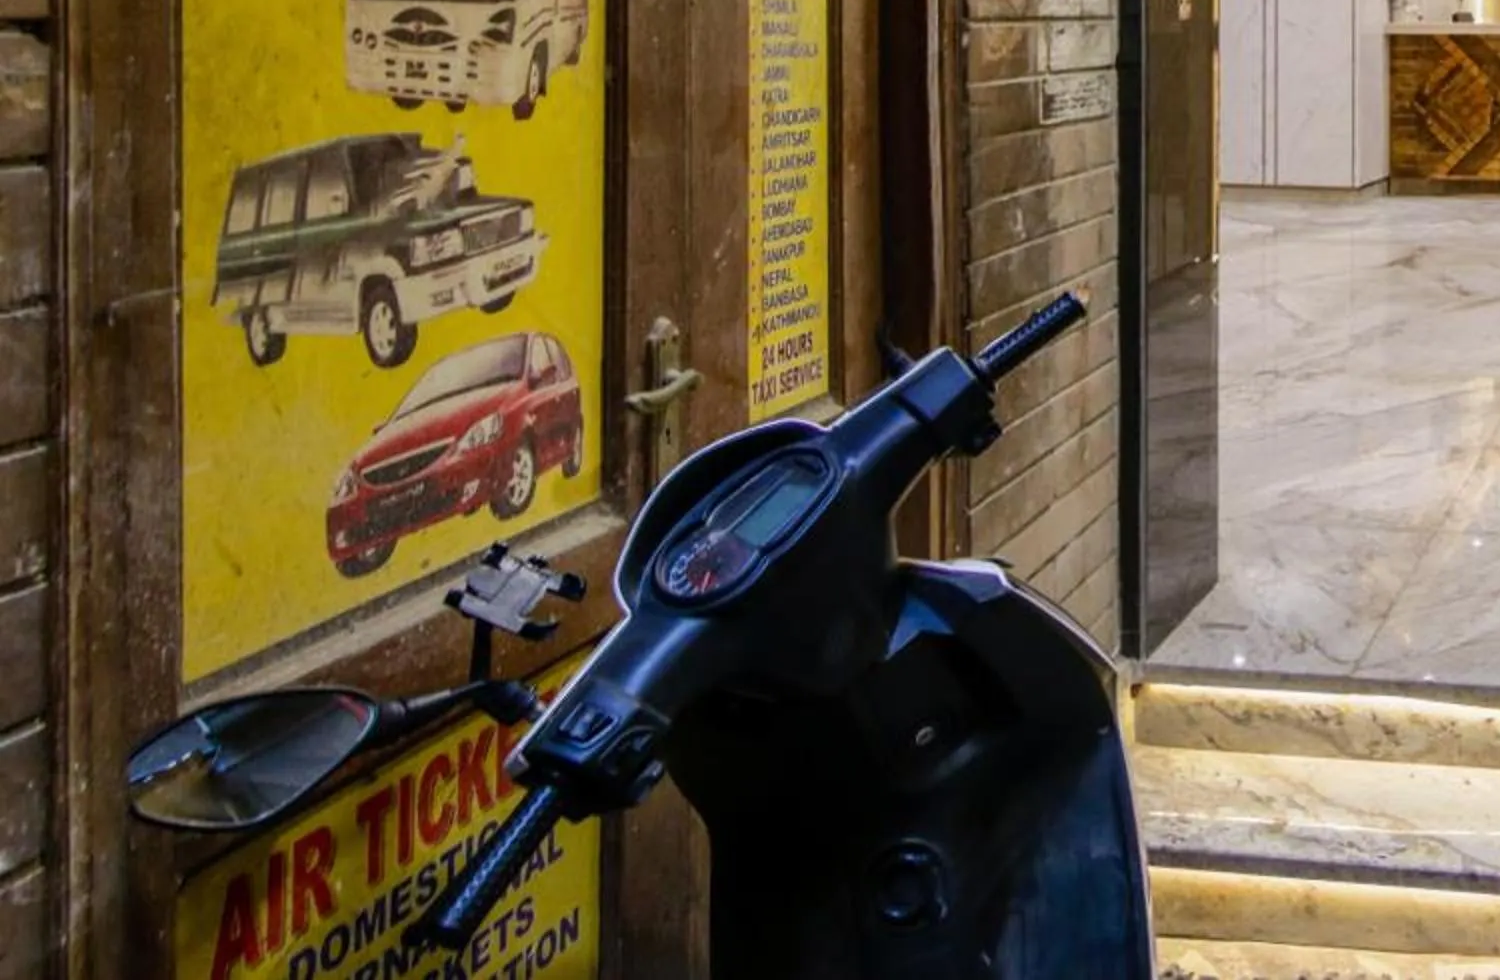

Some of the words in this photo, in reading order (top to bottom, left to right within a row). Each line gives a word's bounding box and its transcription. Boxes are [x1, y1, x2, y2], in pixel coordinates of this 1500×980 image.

[762, 267, 793, 289] NEPAL
[762, 343, 775, 370] 24
[776, 331, 813, 364] HOURS
[751, 376, 776, 406] TAXI
[779, 358, 824, 395] SERVICE
[210, 824, 339, 980] AIR
